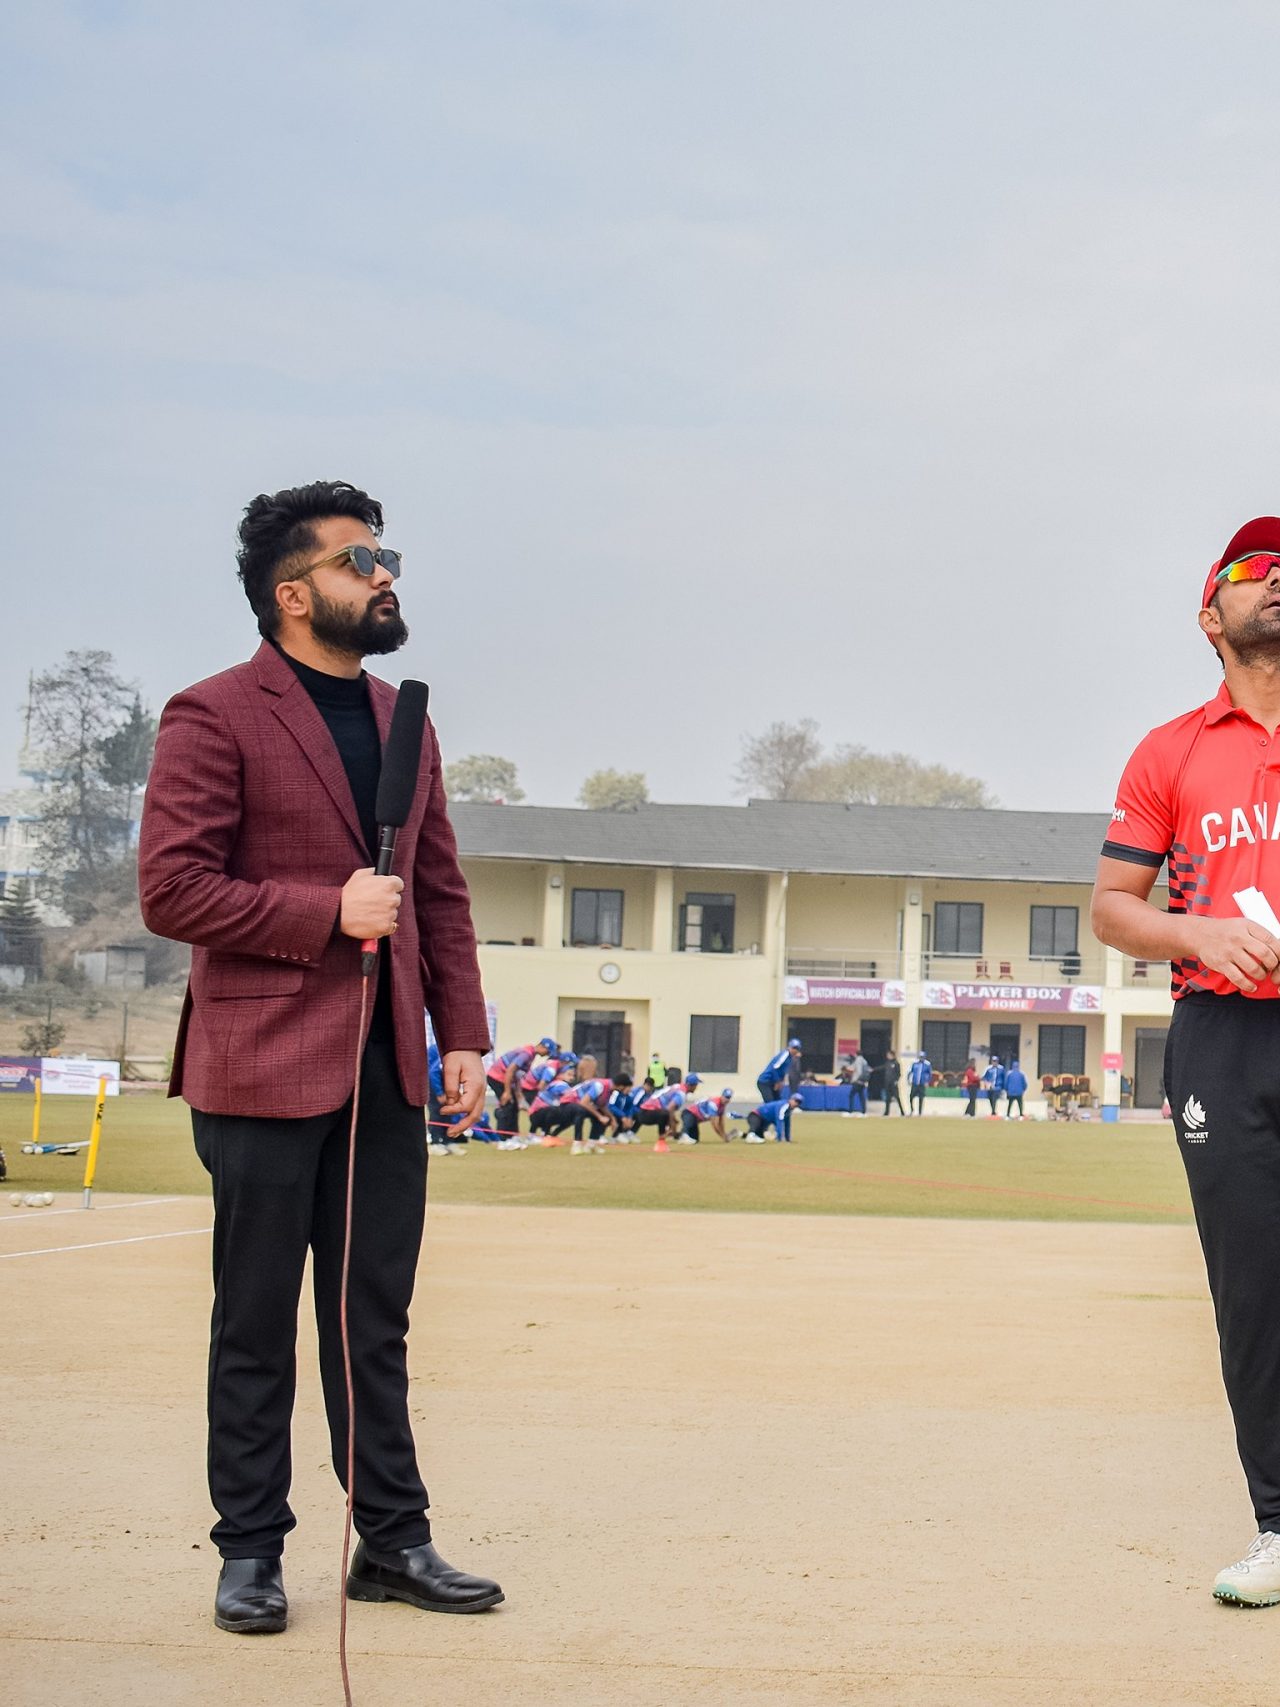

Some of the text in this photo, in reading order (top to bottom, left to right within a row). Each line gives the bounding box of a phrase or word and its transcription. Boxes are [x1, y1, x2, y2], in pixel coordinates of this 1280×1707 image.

[956, 985, 1062, 1000] PLAYER BOX
[989, 1000, 1028, 1009] HOME
